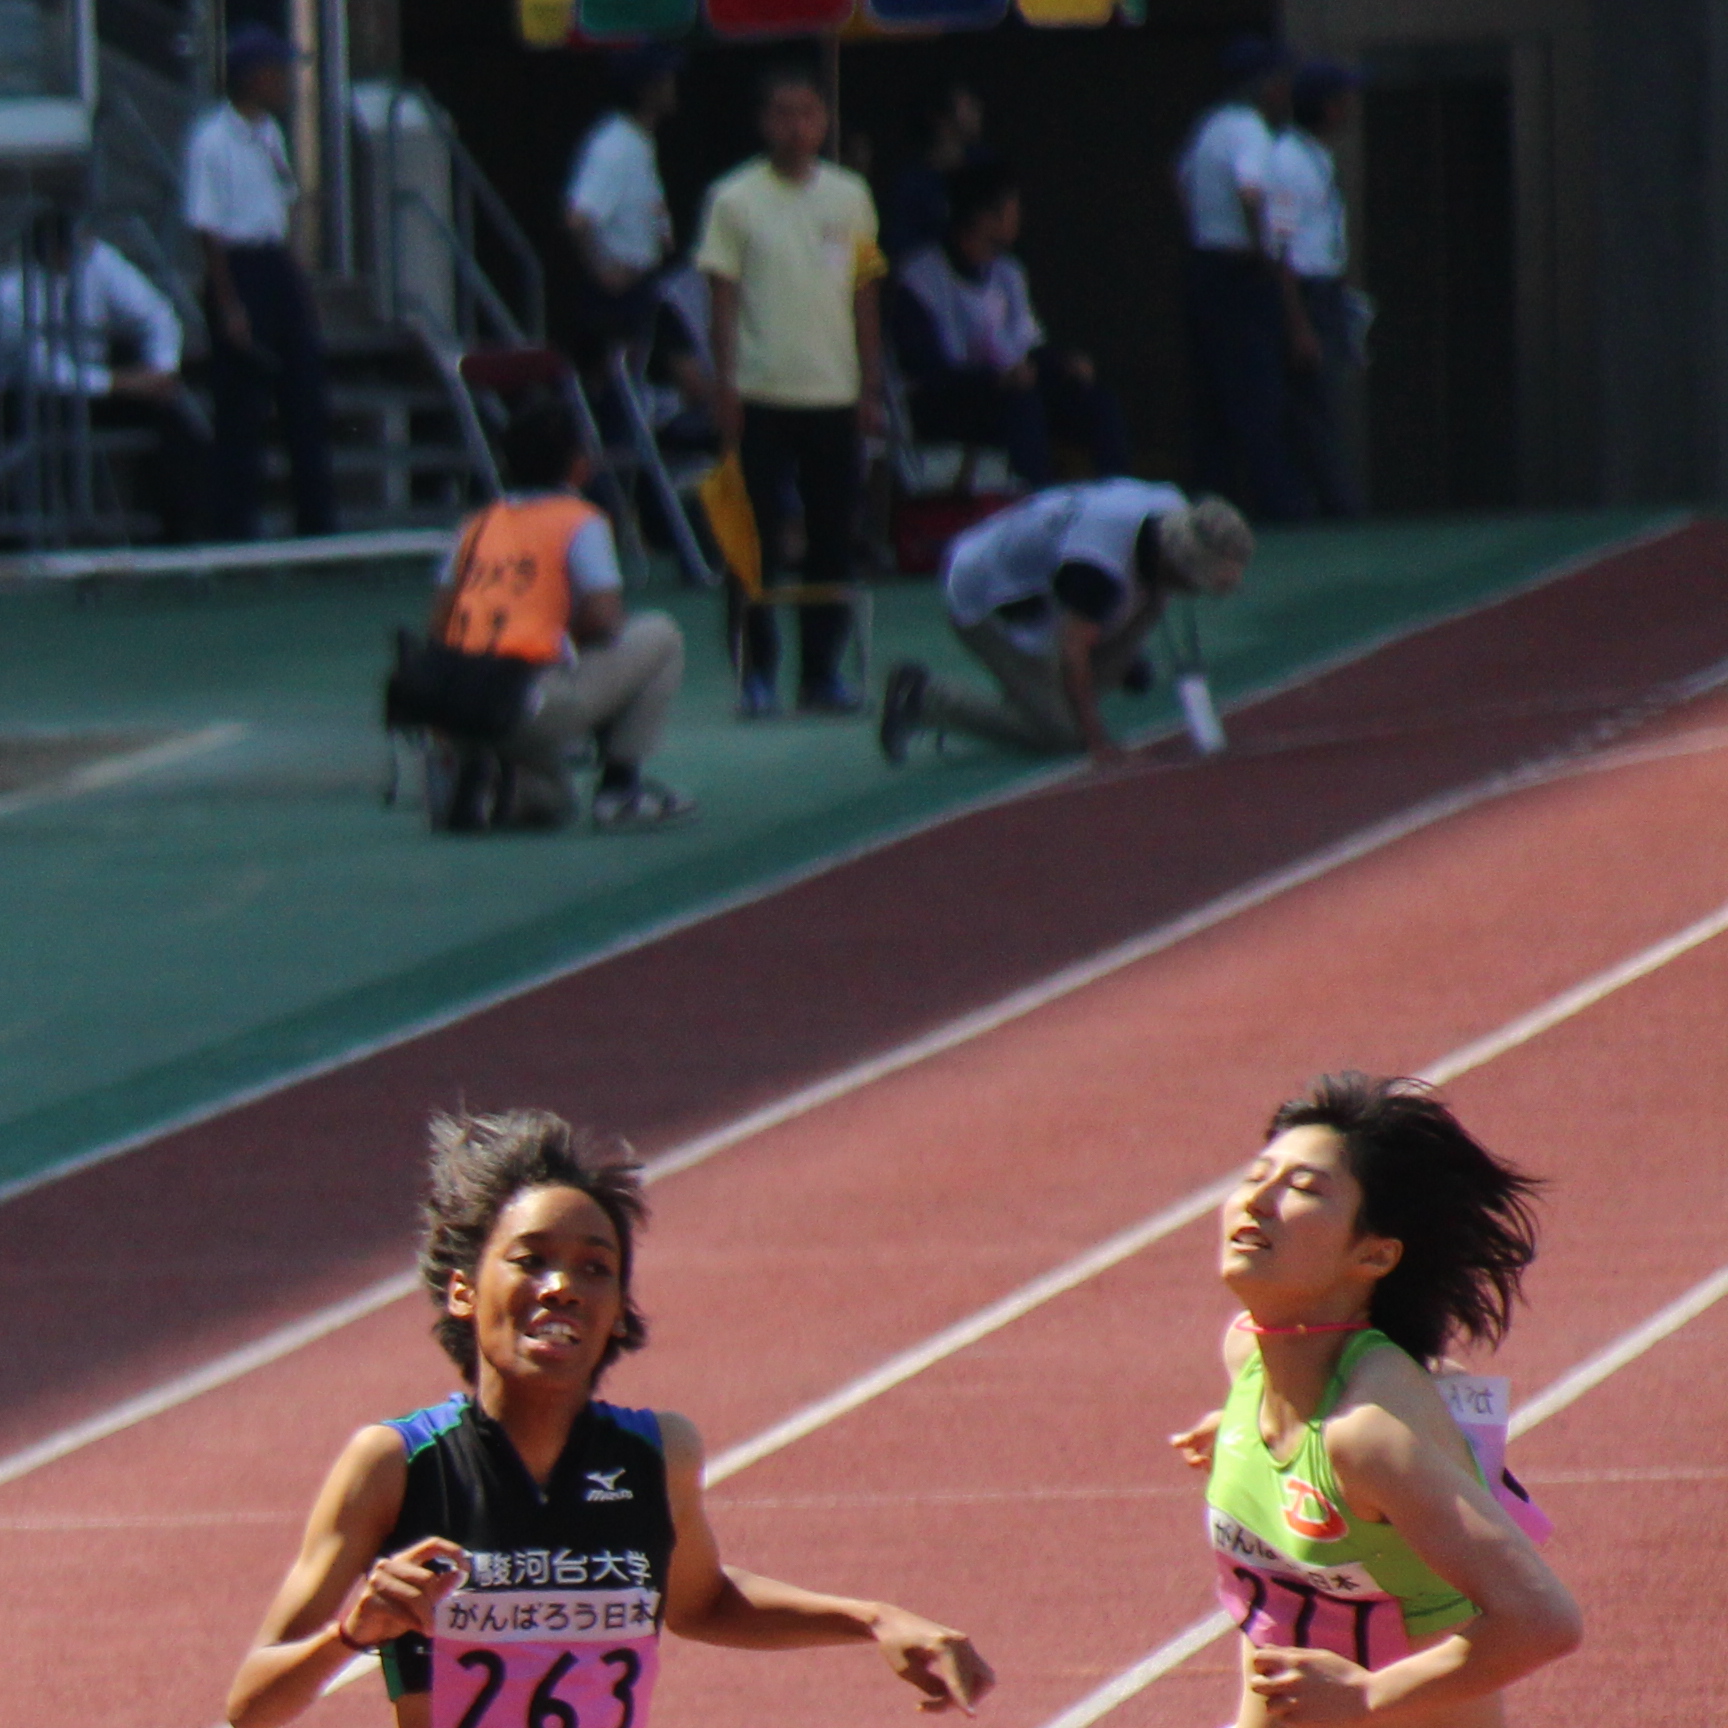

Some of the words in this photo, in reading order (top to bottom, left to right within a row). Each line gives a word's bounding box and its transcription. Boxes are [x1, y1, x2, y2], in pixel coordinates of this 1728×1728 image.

[448, 1602, 655, 1632] がんばろう日本
